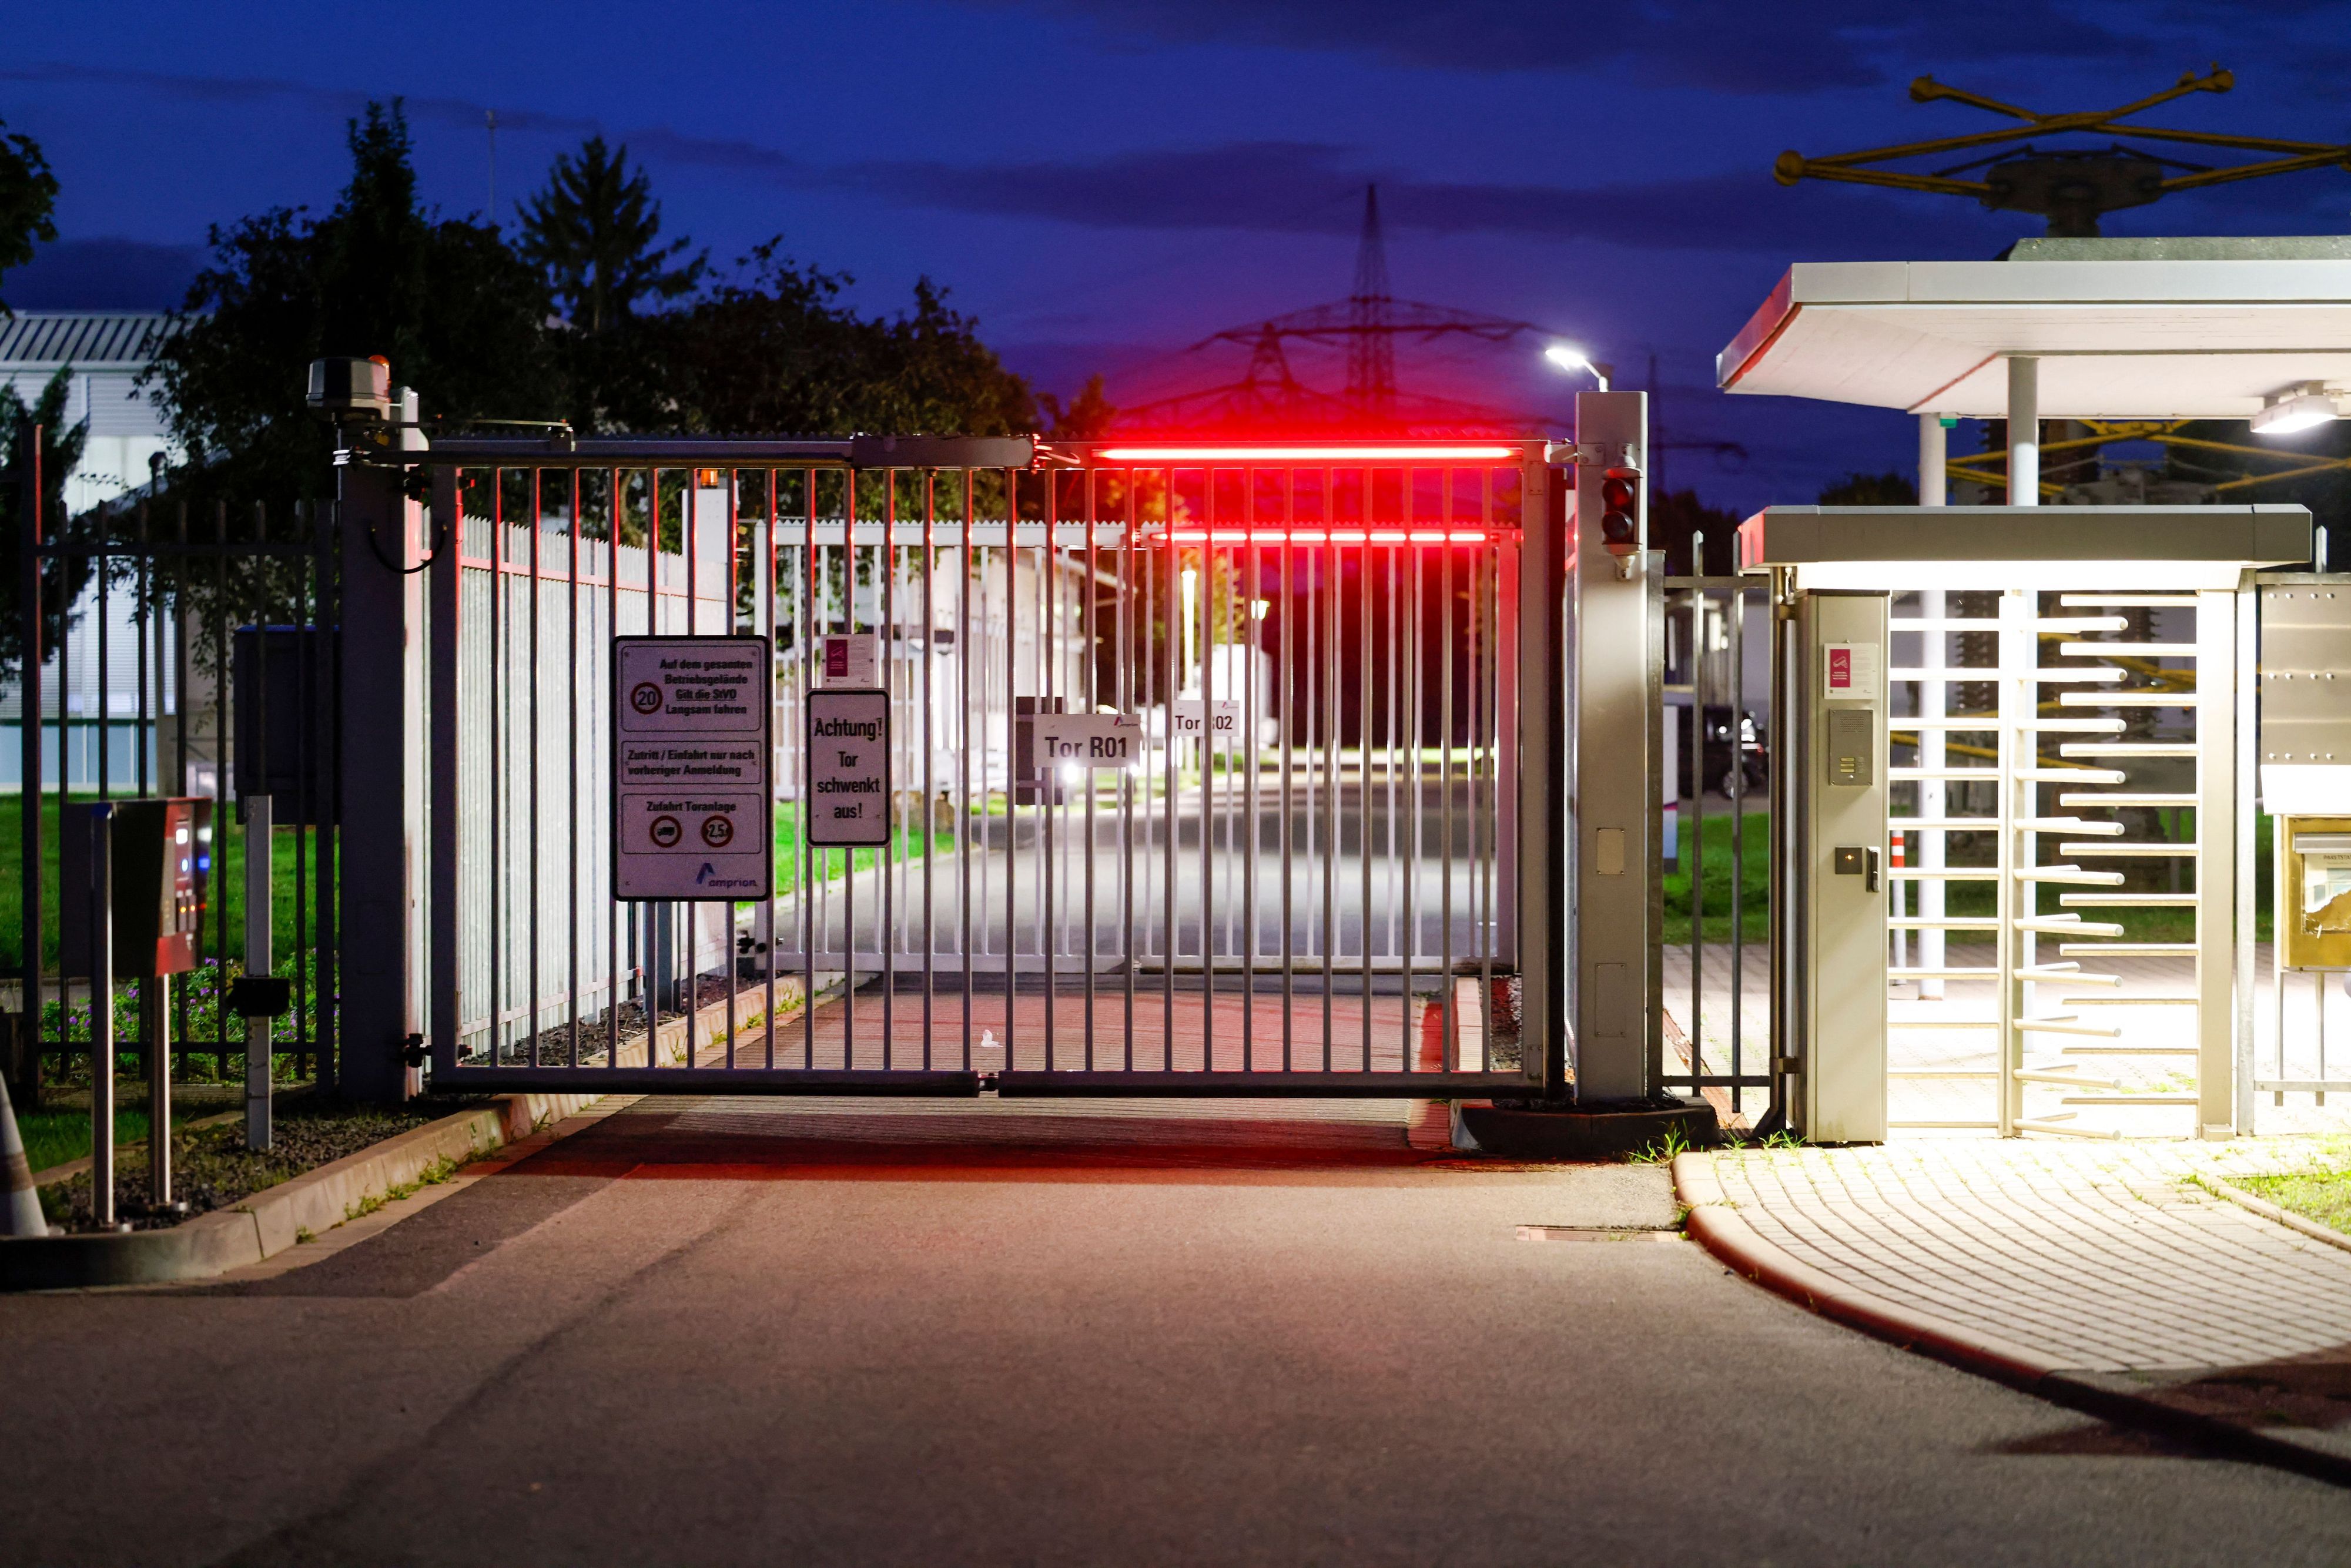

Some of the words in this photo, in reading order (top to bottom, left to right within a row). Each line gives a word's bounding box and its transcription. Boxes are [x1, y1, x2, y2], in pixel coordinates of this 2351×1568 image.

[659, 659, 677, 669] Auf
[680, 659, 701, 669] dem
[704, 660, 752, 671] gesamten
[664, 674, 748, 686] Betriebsgelände
[637, 691, 657, 706] 20
[676, 689, 693, 699] Gilt
[695, 689, 711, 699] die
[713, 689, 737, 699] StVO
[665, 704, 711, 716] Langsam
[714, 704, 747, 714] fahren
[1175, 715, 1201, 730] Tor
[1212, 715, 1233, 730] 02
[814, 718, 882, 742] Achtung!
[1044, 736, 1083, 758] Tor
[1090, 736, 1127, 758] R01
[627, 749, 659, 760] Zutritt
[668, 749, 708, 760] Einfahrt
[710, 752, 727, 760] nur
[729, 749, 755, 760] nach
[838, 751, 858, 767] Tor
[628, 765, 681, 777] vorheriger
[684, 765, 742, 777] Anmeldung
[818, 777, 880, 793] schwenkt
[647, 800, 683, 812] Zufahrt
[685, 800, 736, 813] Toranlage
[834, 803, 862, 819] aus!
[708, 879, 756, 889] amprion
